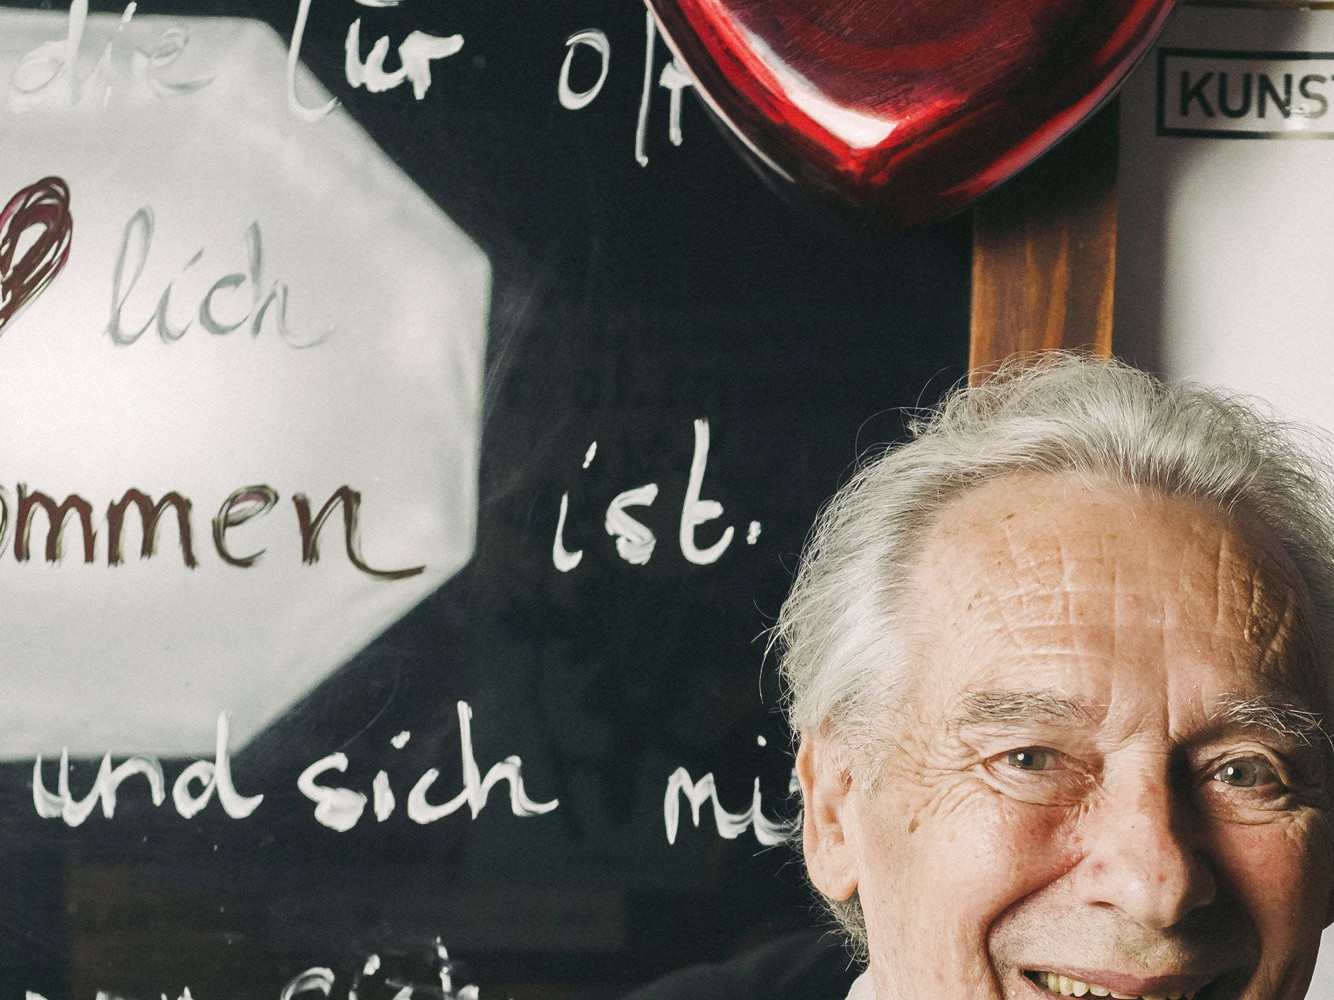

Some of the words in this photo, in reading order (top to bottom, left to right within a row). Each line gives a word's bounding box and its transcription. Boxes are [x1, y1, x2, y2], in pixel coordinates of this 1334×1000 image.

[10, 0, 218, 112] die
[100, 206, 340, 350] lich
[551, 417, 762, 573] ist.
[33, 710, 265, 828] und
[297, 700, 558, 832] sich
